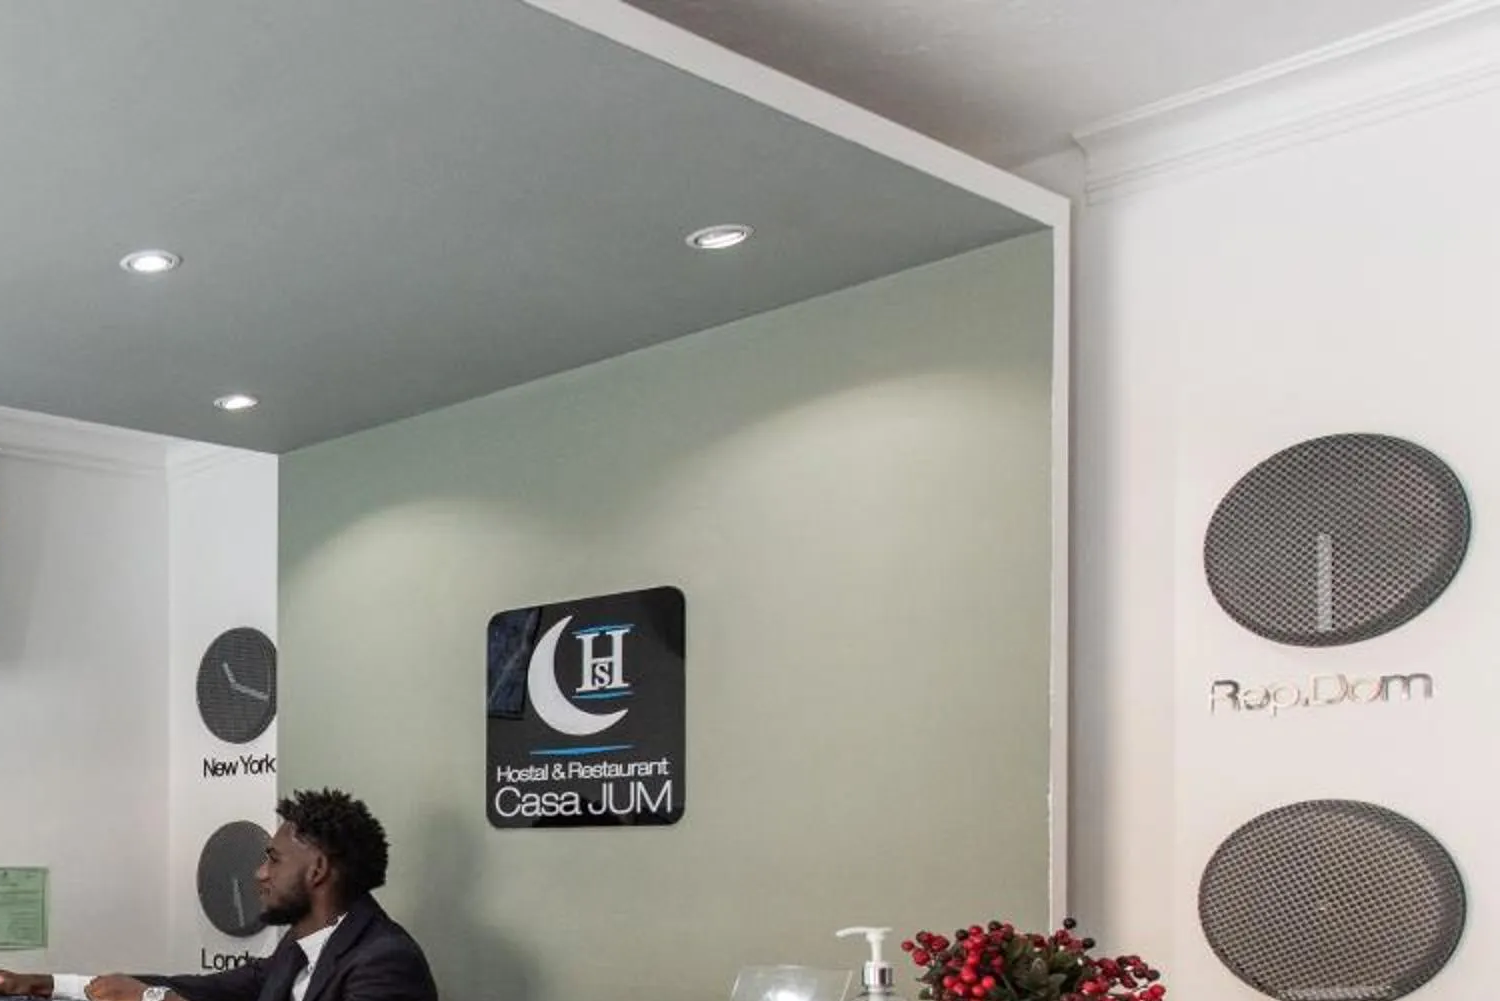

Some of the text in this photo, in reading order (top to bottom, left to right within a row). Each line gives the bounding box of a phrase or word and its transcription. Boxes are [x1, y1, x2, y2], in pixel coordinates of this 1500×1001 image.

[203, 754, 276, 778] New York
[497, 758, 669, 783] Hostal & Restaurant
[495, 780, 673, 817] Casa JUM
[202, 947, 250, 970] Lond
